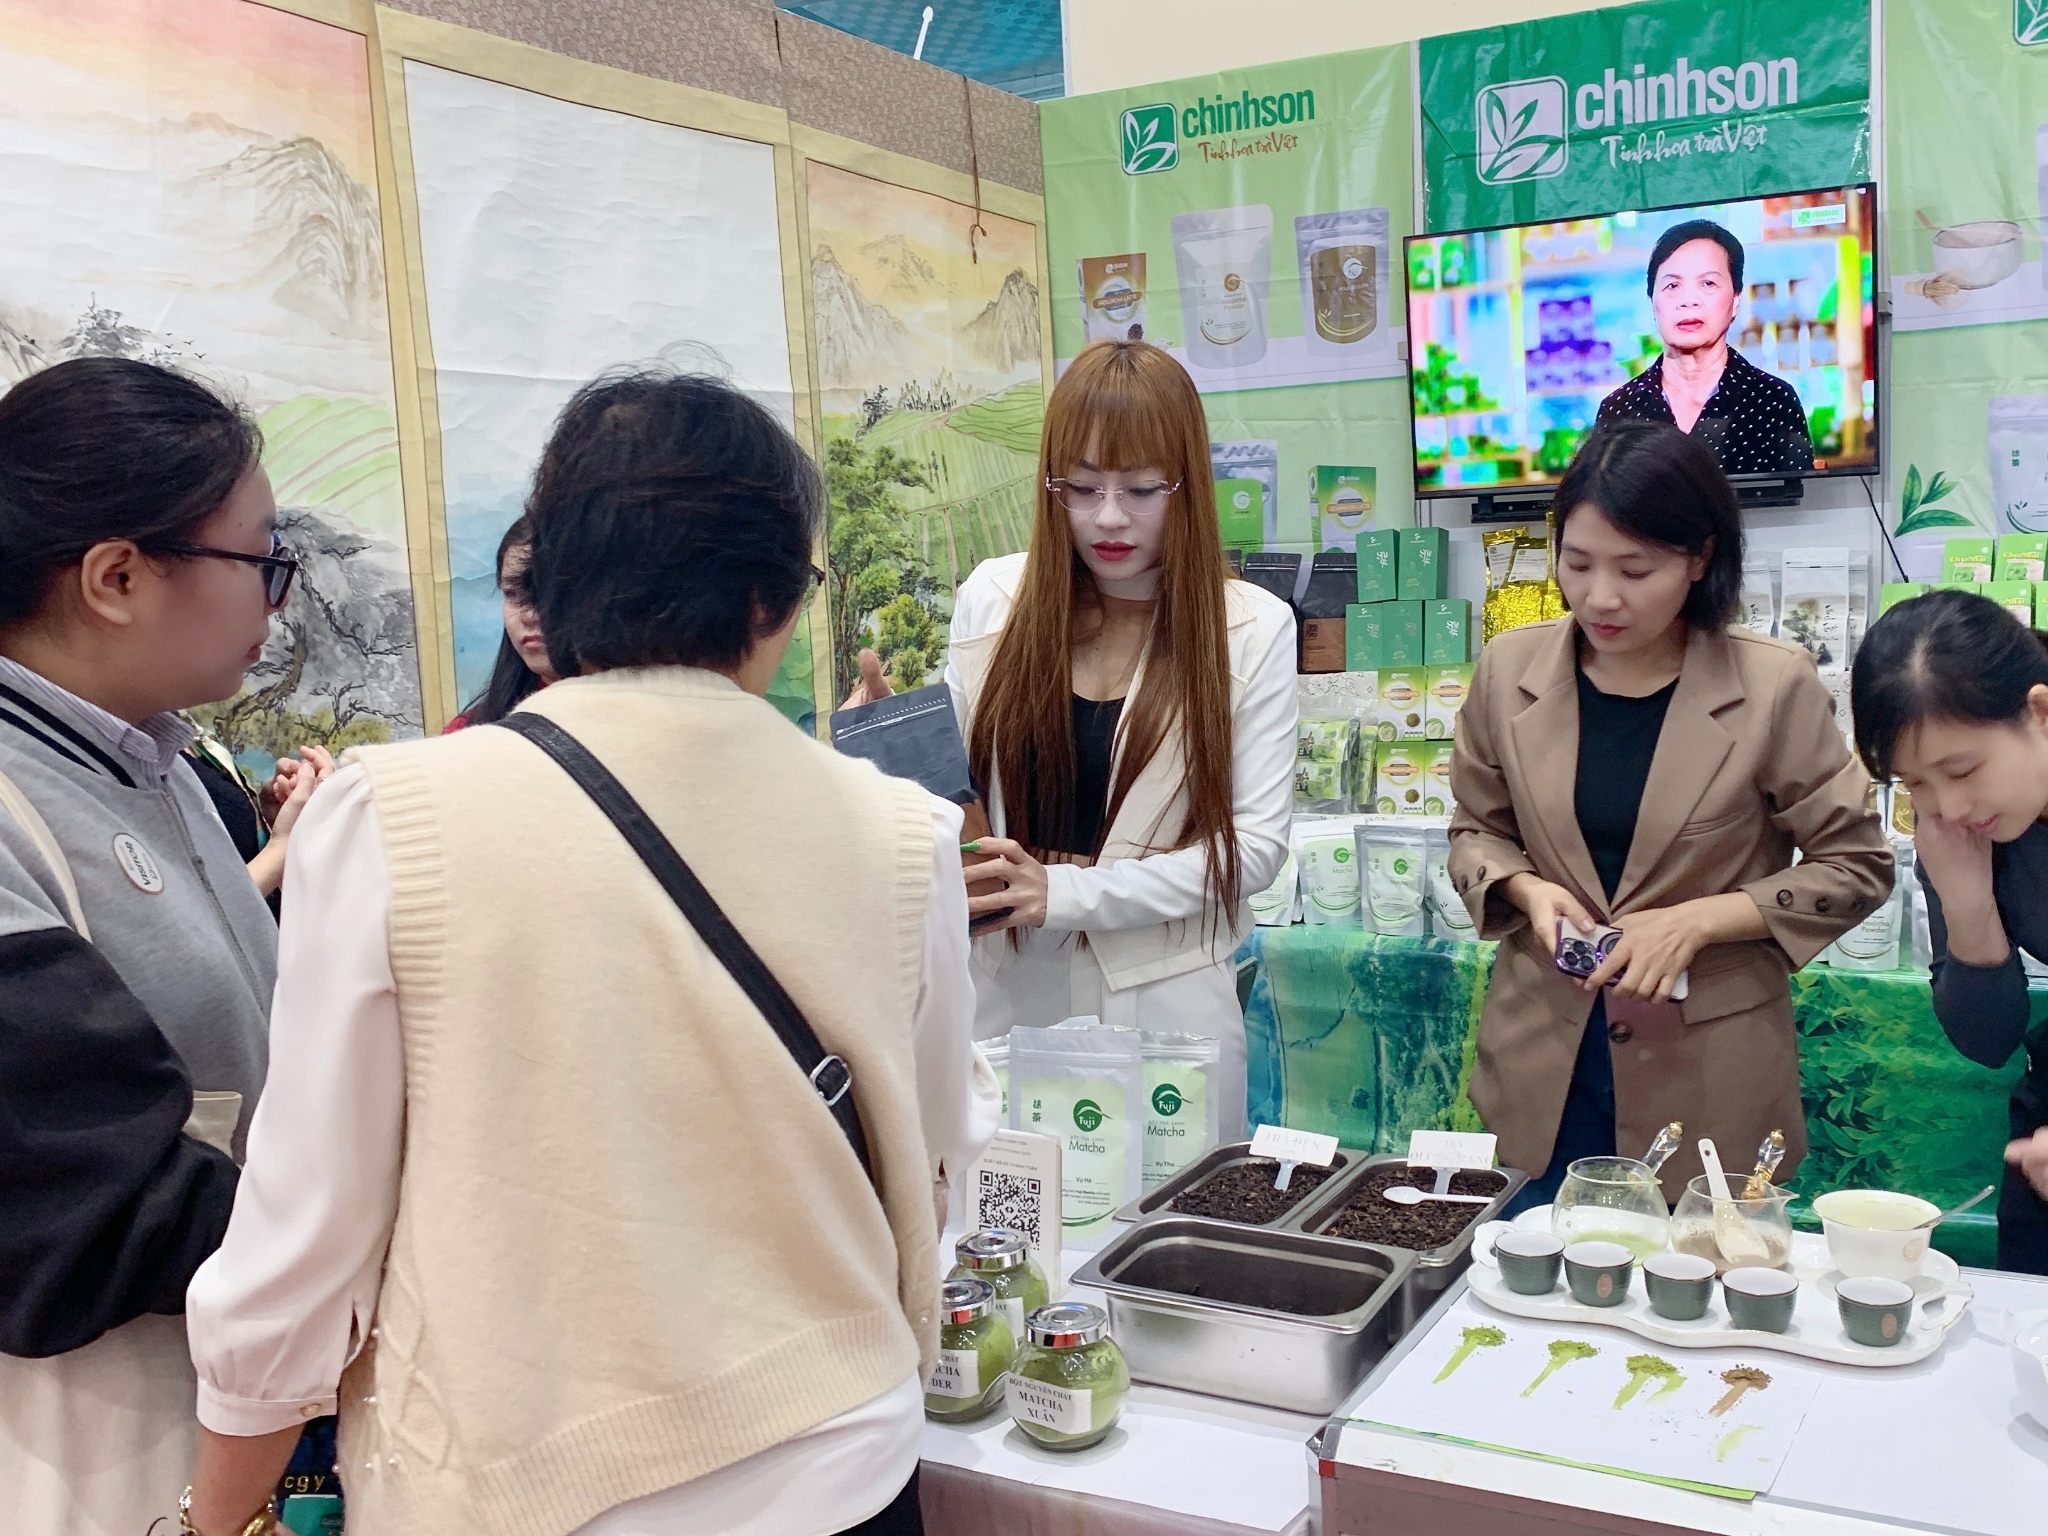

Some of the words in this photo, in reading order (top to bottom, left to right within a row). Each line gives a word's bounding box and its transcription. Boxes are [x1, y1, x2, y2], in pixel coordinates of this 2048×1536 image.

[1575, 57, 1798, 130] chinhson
[1182, 89, 1315, 139] chinhson
[1198, 139, 1229, 163] Tinh
[1230, 138, 1254, 159] hoa
[1255, 136, 1272, 153] trà
[1270, 131, 1299, 153] Việt
[1601, 131, 1653, 168] Tinh
[1653, 130, 1690, 162] hoa
[1694, 126, 1723, 154] trà
[1721, 120, 1768, 153] Việt
[125, 841, 151, 886] VISITOR
[1158, 1101, 1175, 1114] Fuji
[1079, 1116, 1096, 1129] Fuji
[1147, 1125, 1186, 1138] Matcha
[1068, 1140, 1106, 1154] Matcha
[932, 1378, 952, 1390] DER
[1019, 1391, 1063, 1412] MATCHA
[1027, 1407, 1056, 1423] XUÂN
